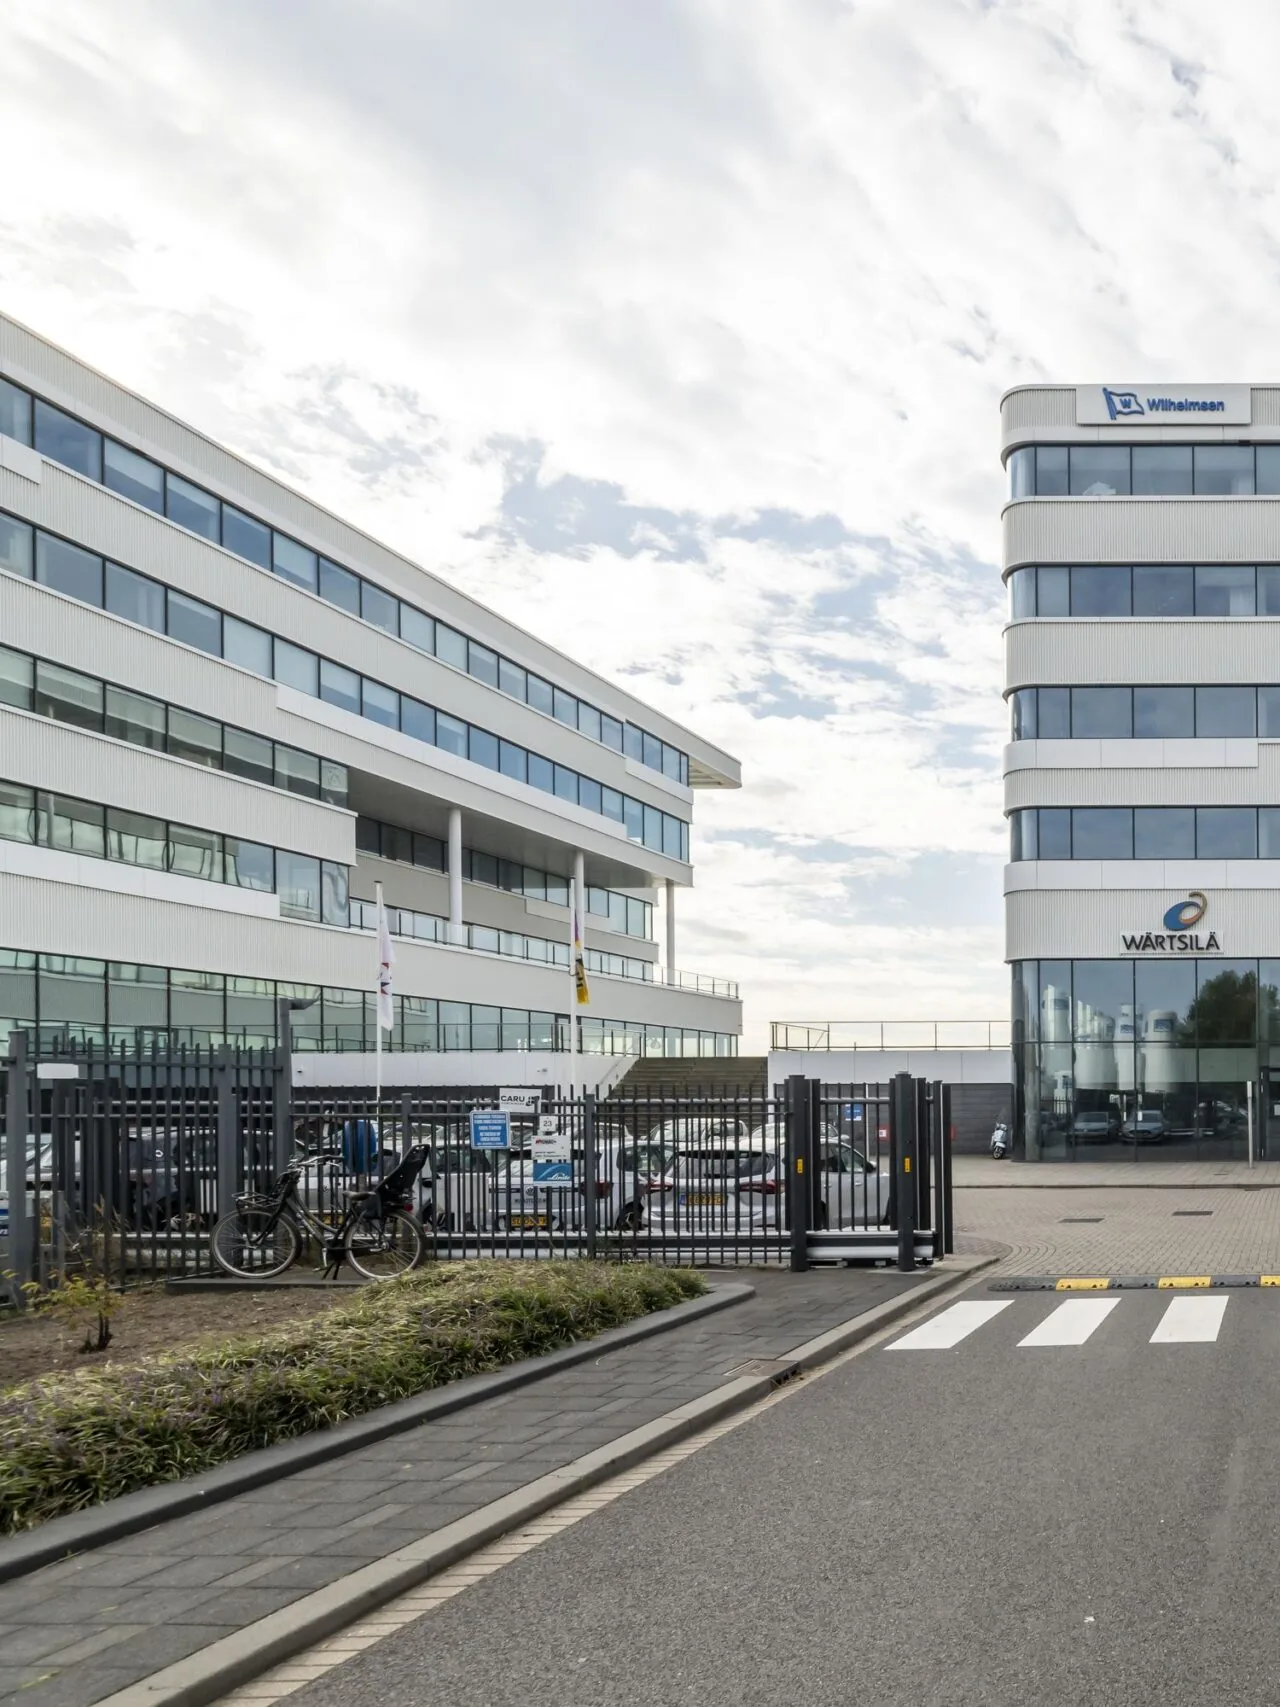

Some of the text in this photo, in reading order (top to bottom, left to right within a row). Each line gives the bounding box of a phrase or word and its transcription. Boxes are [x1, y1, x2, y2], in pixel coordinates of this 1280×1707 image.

[1147, 398, 1225, 412] Wilhelmsen
[1121, 931, 1220, 951] WÄRTSILÄ
[500, 1095, 525, 1103] CARU
